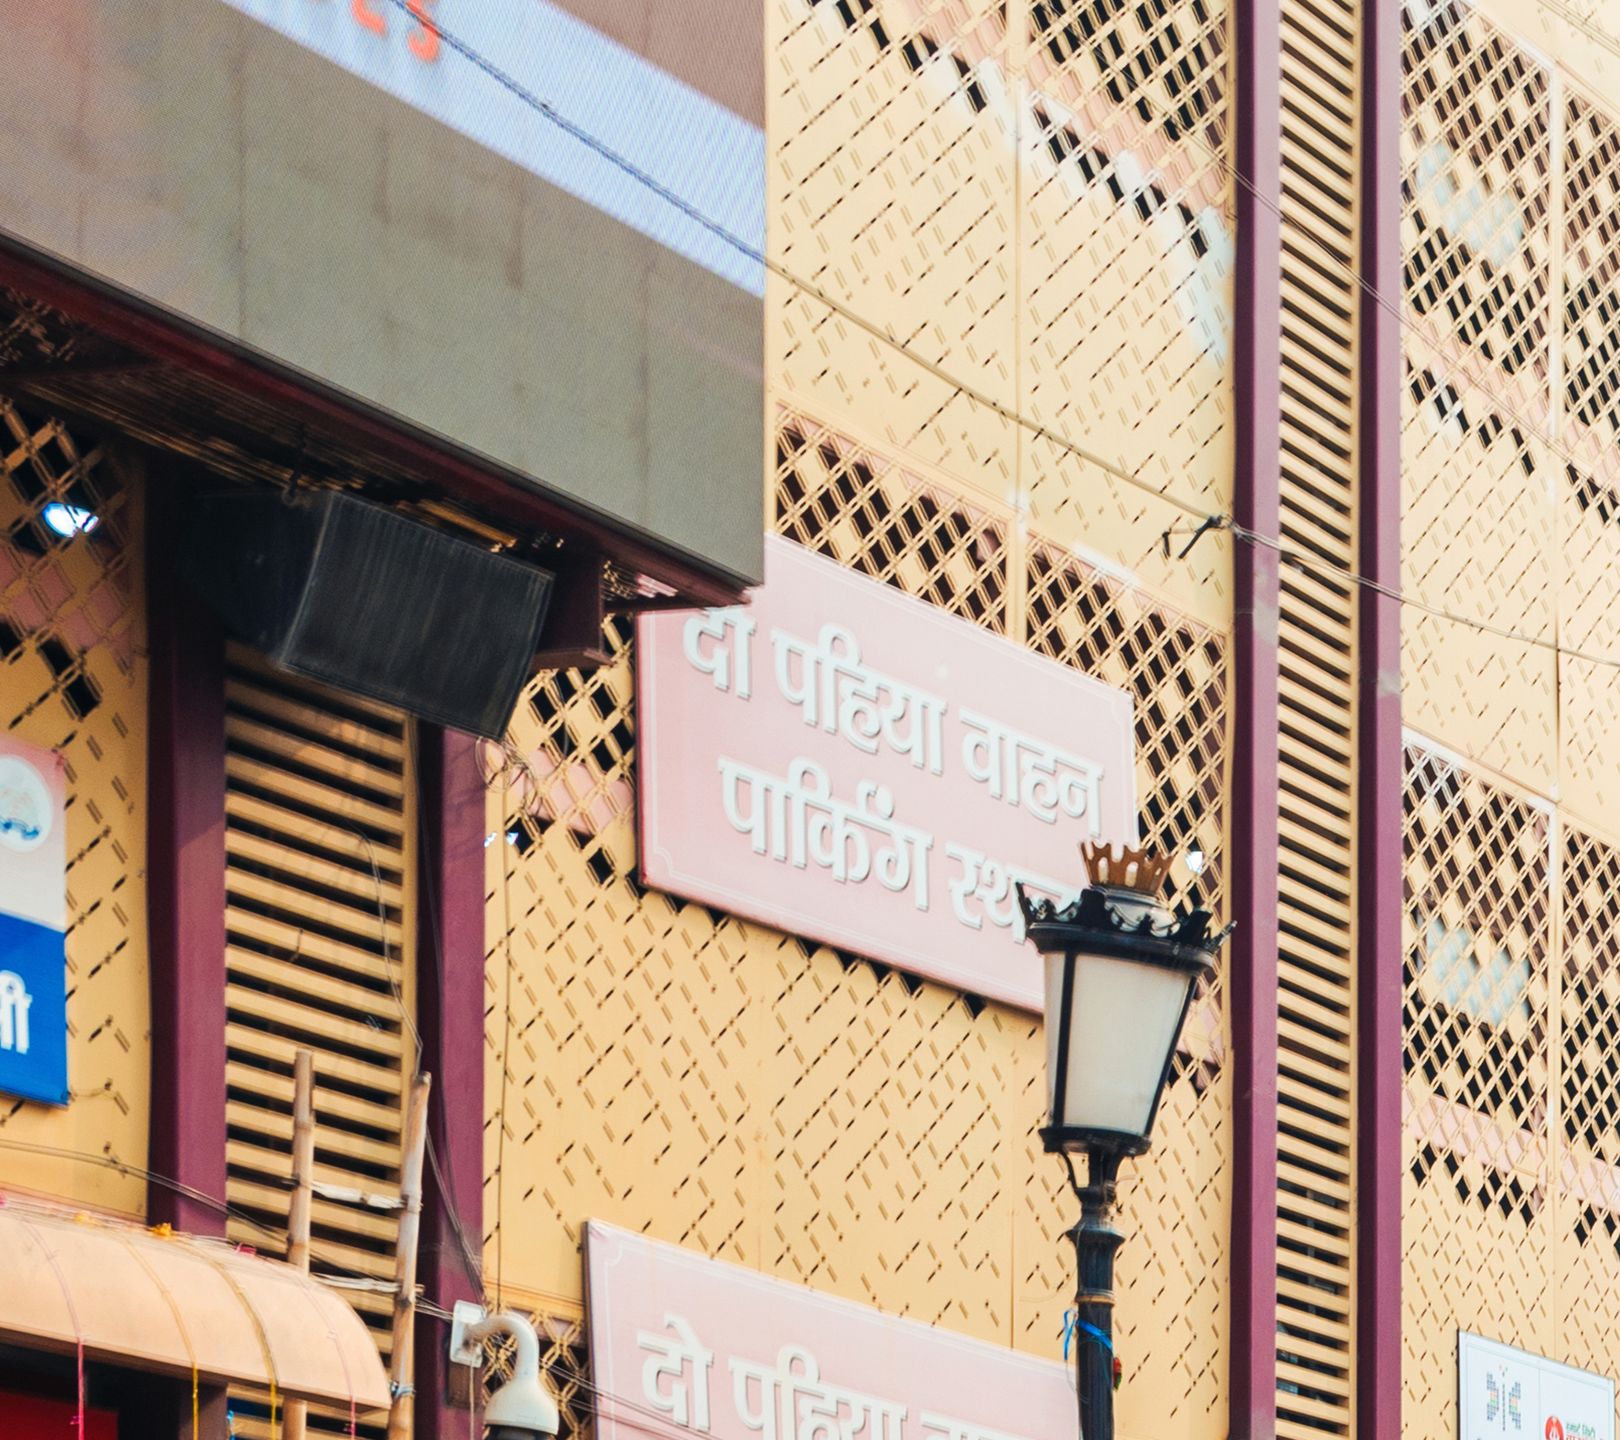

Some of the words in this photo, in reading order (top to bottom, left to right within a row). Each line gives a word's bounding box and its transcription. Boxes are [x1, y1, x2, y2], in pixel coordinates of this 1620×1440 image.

[771, 623, 947, 777] पहिया
[960, 706, 1105, 838] वाहन
[717, 756, 934, 911] पार्किंग
[636, 1314, 714, 1431] दो
